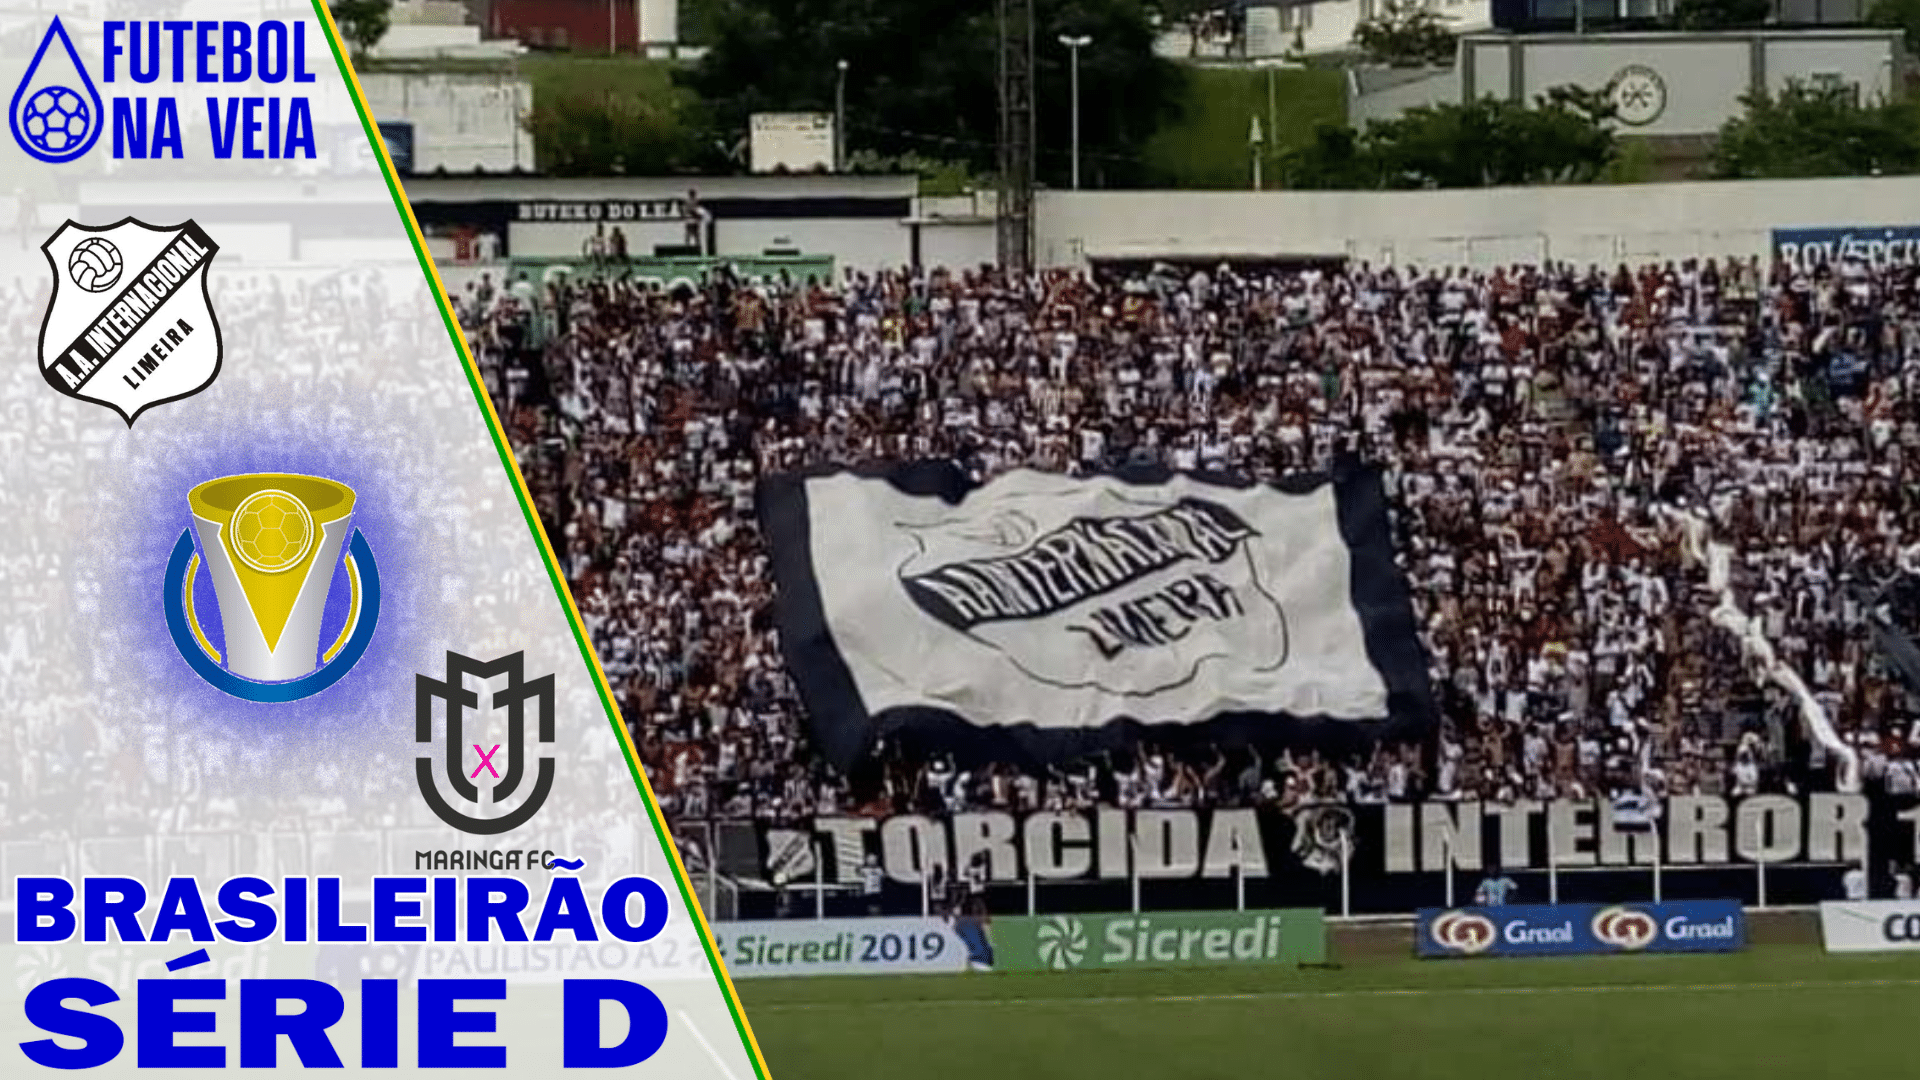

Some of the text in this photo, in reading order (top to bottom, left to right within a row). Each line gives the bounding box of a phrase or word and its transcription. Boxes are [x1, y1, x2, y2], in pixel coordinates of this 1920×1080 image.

[608, 204, 634, 218] DO
[815, 809, 1270, 882] TORCIDA
[1384, 794, 1869, 872] INTERROR
[1103, 915, 1282, 963] Sicredi
[1504, 920, 1574, 943] Graal
[1665, 915, 1735, 940] Graal
[734, 931, 854, 965] Sicredi
[860, 932, 946, 962] 2019
